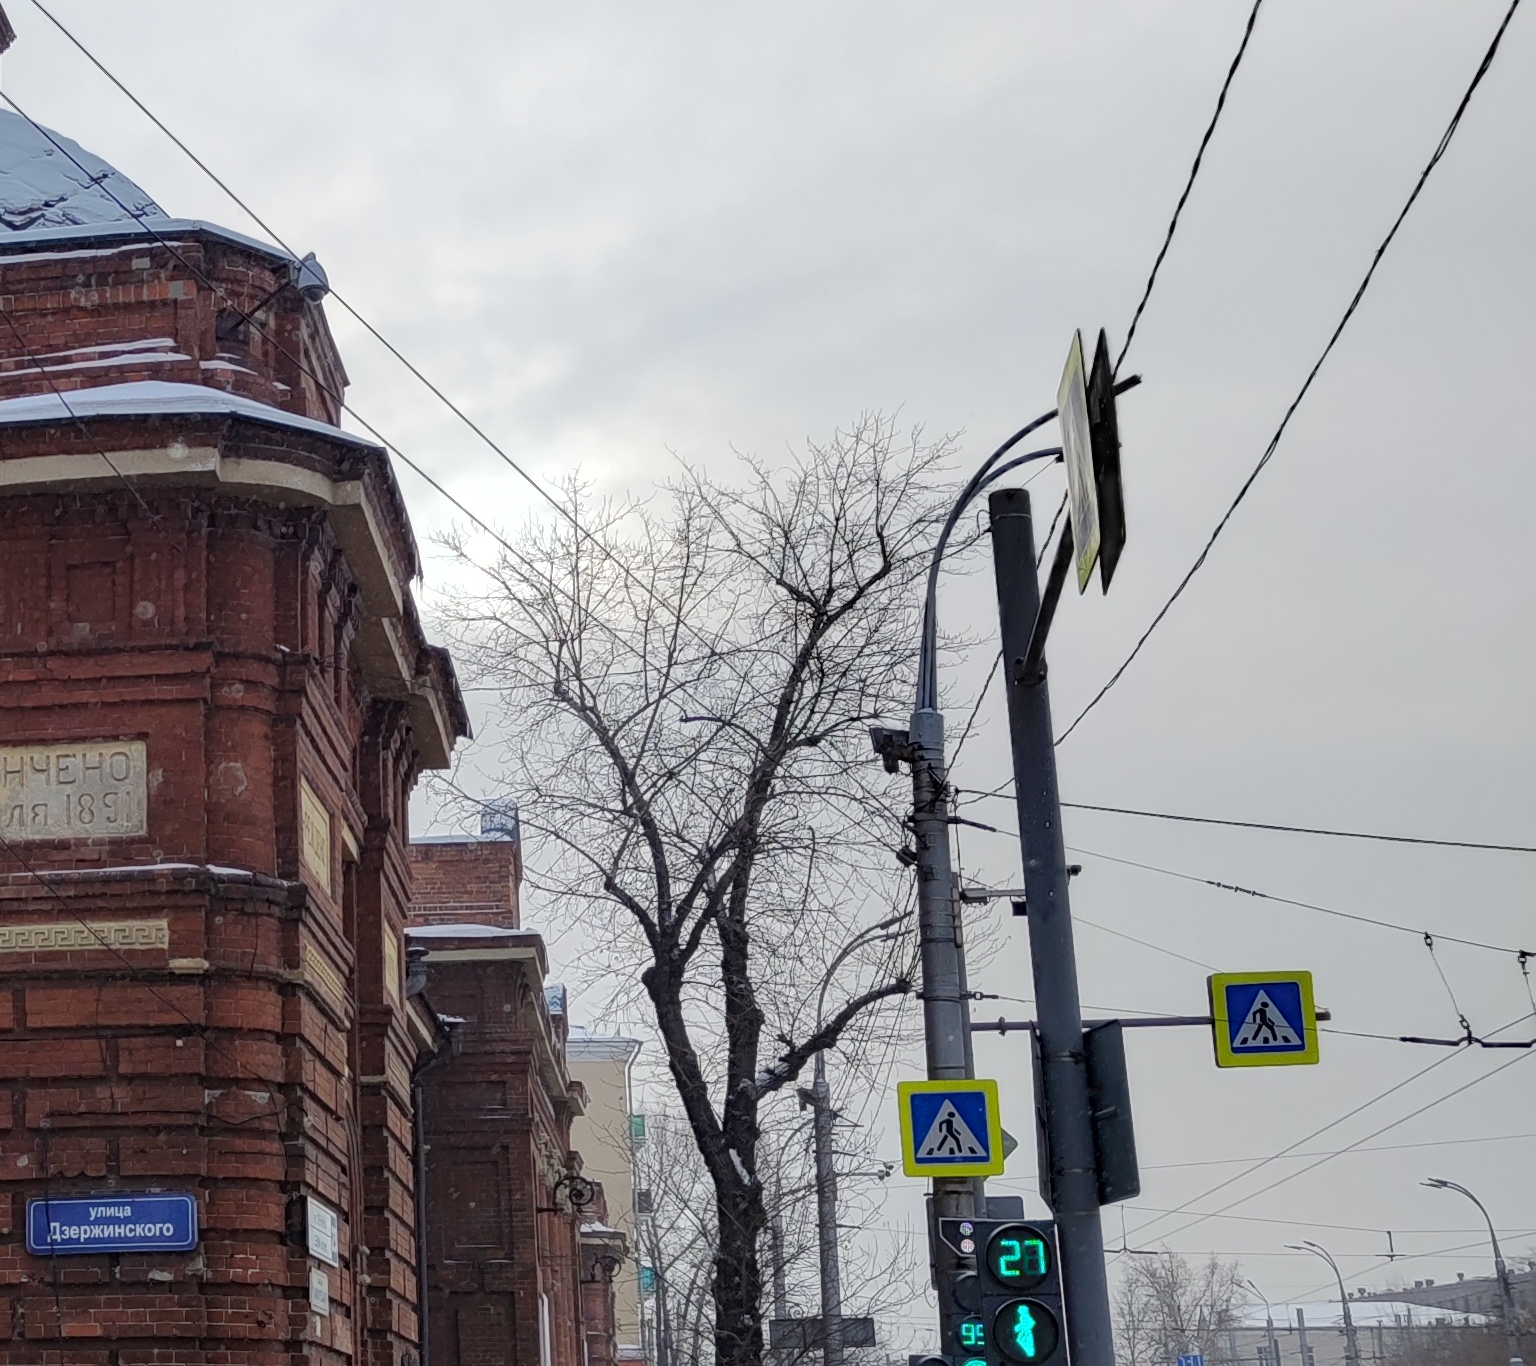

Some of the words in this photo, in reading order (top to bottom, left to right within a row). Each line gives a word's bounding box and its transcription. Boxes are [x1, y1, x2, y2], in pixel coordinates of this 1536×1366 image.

[65, 791, 132, 826] 1891
[89, 1205, 132, 1221] улица
[47, 1222, 174, 1243] Дзержинского
[999, 1238, 1047, 1276] 27
